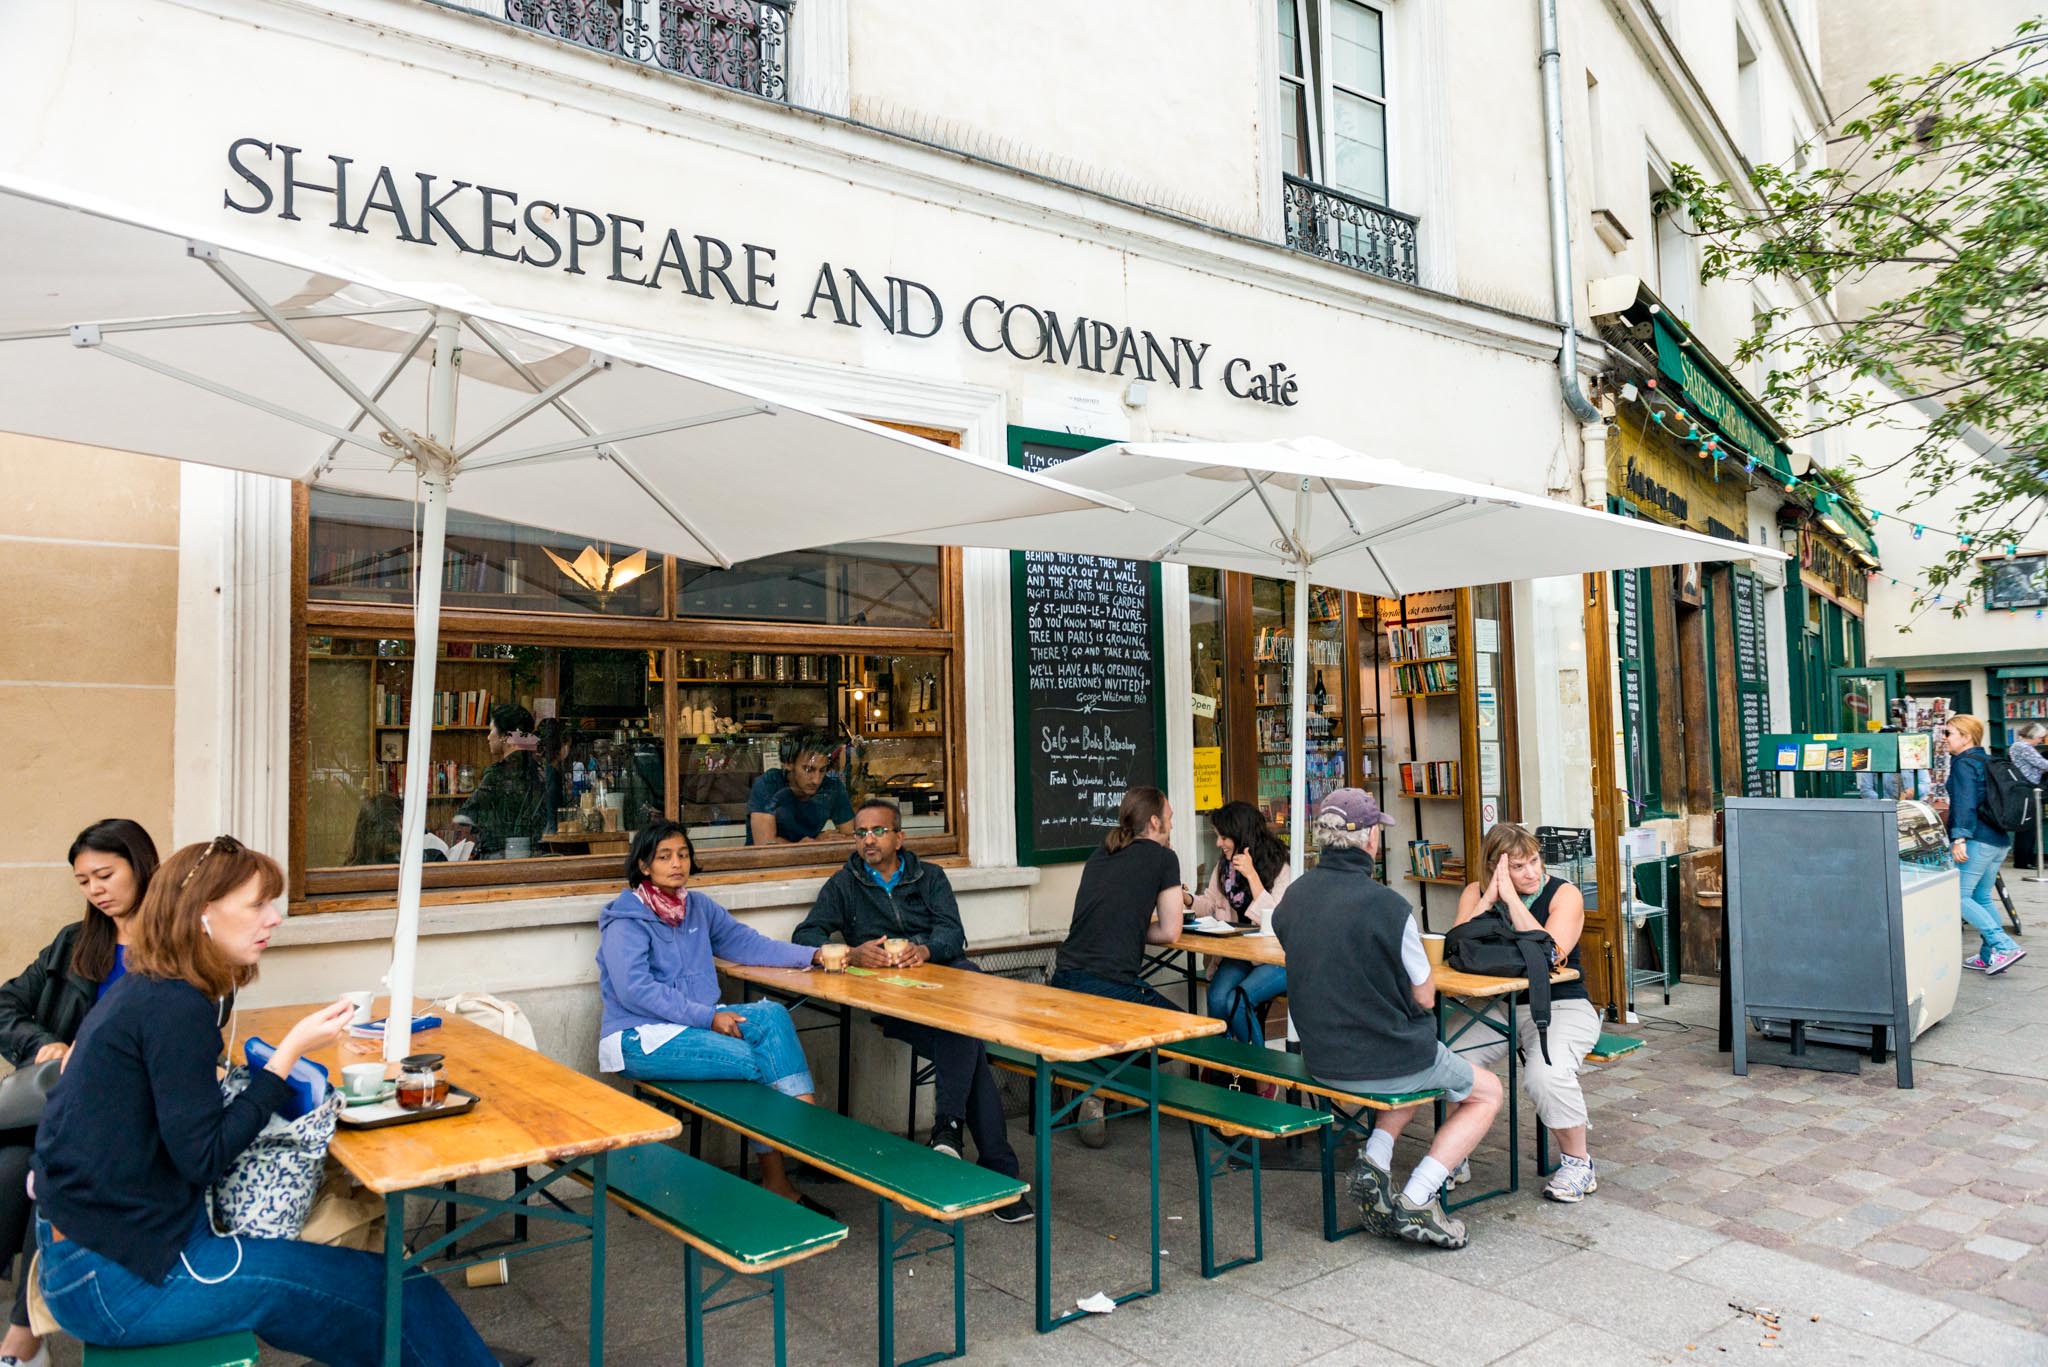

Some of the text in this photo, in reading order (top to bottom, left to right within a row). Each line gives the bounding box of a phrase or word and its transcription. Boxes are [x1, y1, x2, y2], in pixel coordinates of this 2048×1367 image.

[224, 137, 1299, 408] SHAKESPEARE AND COMPANY Café
[1025, 551, 1136, 572] BEHIND THIS ONE. THEN WE
[1027, 564, 1142, 585] CAN KNOCK OUT A WALL,
[1027, 575, 1145, 597] AND THE STORE WILL REACH
[1027, 588, 1145, 610] RIGHT BACK INTO THE GARDEN
[1029, 602, 1040, 617] of
[1029, 617, 1148, 635] DID YOU KNOW THAT THE OLDEST
[1029, 630, 1145, 649] TREE IN PARIS IS GROWING
[1072, 647, 1082, 658] GO
[1084, 647, 1100, 656] AND
[1103, 647, 1122, 658] TAKE
[1124, 650, 1130, 659] A
[1308, 639, 1342, 665] COMPANY
[1029, 663, 1144, 680] WE'LL HAVE A BIG OPENING
[1030, 678, 1056, 690] PARTY.
[1076, 692, 1101, 706] George
[1102, 691, 1131, 703] Whitman
[1191, 697, 1212, 711] Open
[1104, 725, 1136, 756] Bakeshop
[1050, 771, 1067, 786] Fresh
[1108, 771, 1127, 787] Salads
[1078, 789, 1087, 800] and
[1093, 792, 1106, 807] HOT
